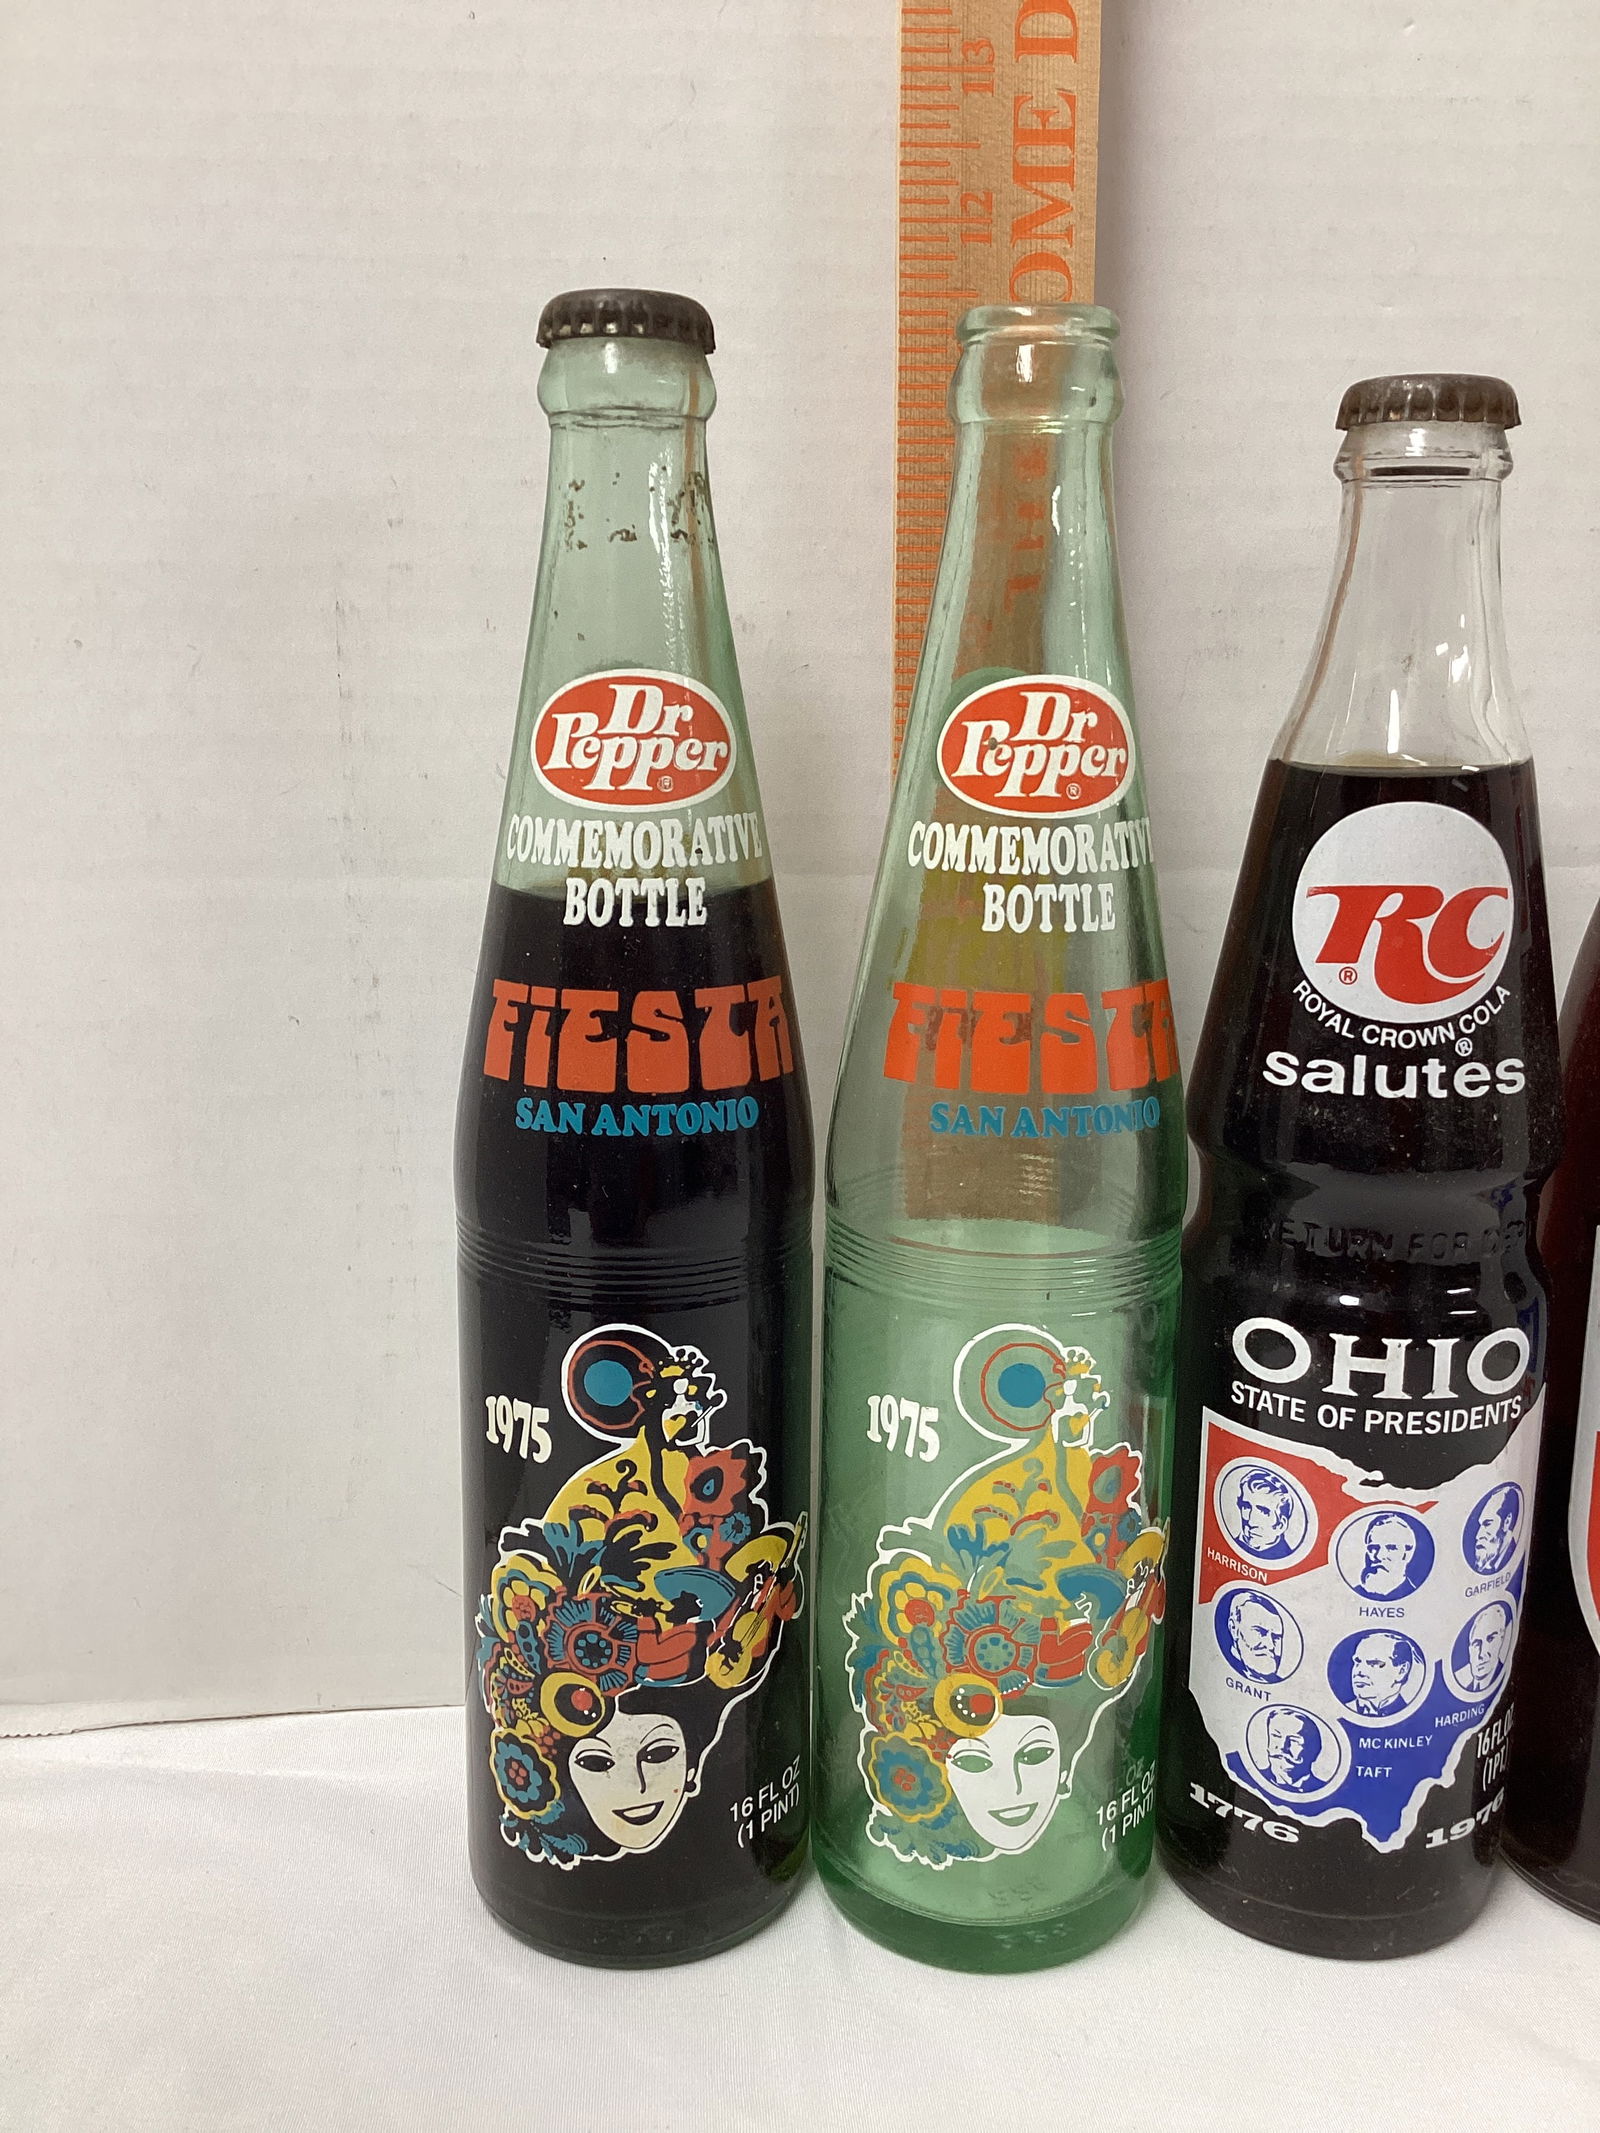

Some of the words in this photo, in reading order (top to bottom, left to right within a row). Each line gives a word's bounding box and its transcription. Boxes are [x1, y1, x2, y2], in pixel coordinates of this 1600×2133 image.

[961, 38, 996, 97] 13
[960, 190, 994, 248] 12
[598, 683, 694, 736] Dr
[1009, 690, 1098, 744] Dr
[542, 712, 730, 792] Pepper
[950, 719, 1127, 799] Pepper
[505, 811, 764, 870] COMMEMORATIVE
[563, 877, 708, 928] BOTTLE
[981, 881, 1117, 934] BOTTLE
[1306, 884, 1509, 1006] RC
[1292, 979, 1356, 1040] ROYAL
[1361, 1022, 1456, 1050] CROWN
[1459, 985, 1511, 1035] COLA
[1262, 1050, 1527, 1100] salutes
[515, 1097, 587, 1136] SAN
[592, 1095, 760, 1138] ANTONIO
[930, 1101, 1004, 1137] SAN
[1010, 1096, 1162, 1138] ANTONIO
[1231, 1316, 1531, 1400] OHIO
[485, 1394, 553, 1464] 1975
[866, 1394, 941, 1463] 1975
[1231, 1380, 1307, 1423] STATE
[1317, 1404, 1355, 1431] OF
[1364, 1394, 1523, 1436] PRESIDENTS
[1206, 1546, 1268, 1585] HARRISON
[1463, 1570, 1511, 1599] GARFIELD
[1358, 1606, 1405, 1619] HAYES
[1225, 1676, 1273, 1701] GRANT
[1434, 1703, 1486, 1729] HARDING
[730, 1796, 754, 1823] 16
[758, 1781, 780, 1810] FL
[781, 1754, 801, 1790] OZ
[1096, 1800, 1118, 1826] 16
[1121, 1786, 1140, 1814] FL
[1141, 1760, 1156, 1794] OZ
[1355, 1765, 1393, 1779] TAFT
[737, 1819, 754, 1849] (1
[761, 1782, 801, 1833] PINT)
[1101, 1824, 1116, 1852] (1
[1188, 1782, 1300, 1845] 1776
[1425, 1786, 1505, 1850] 1976
